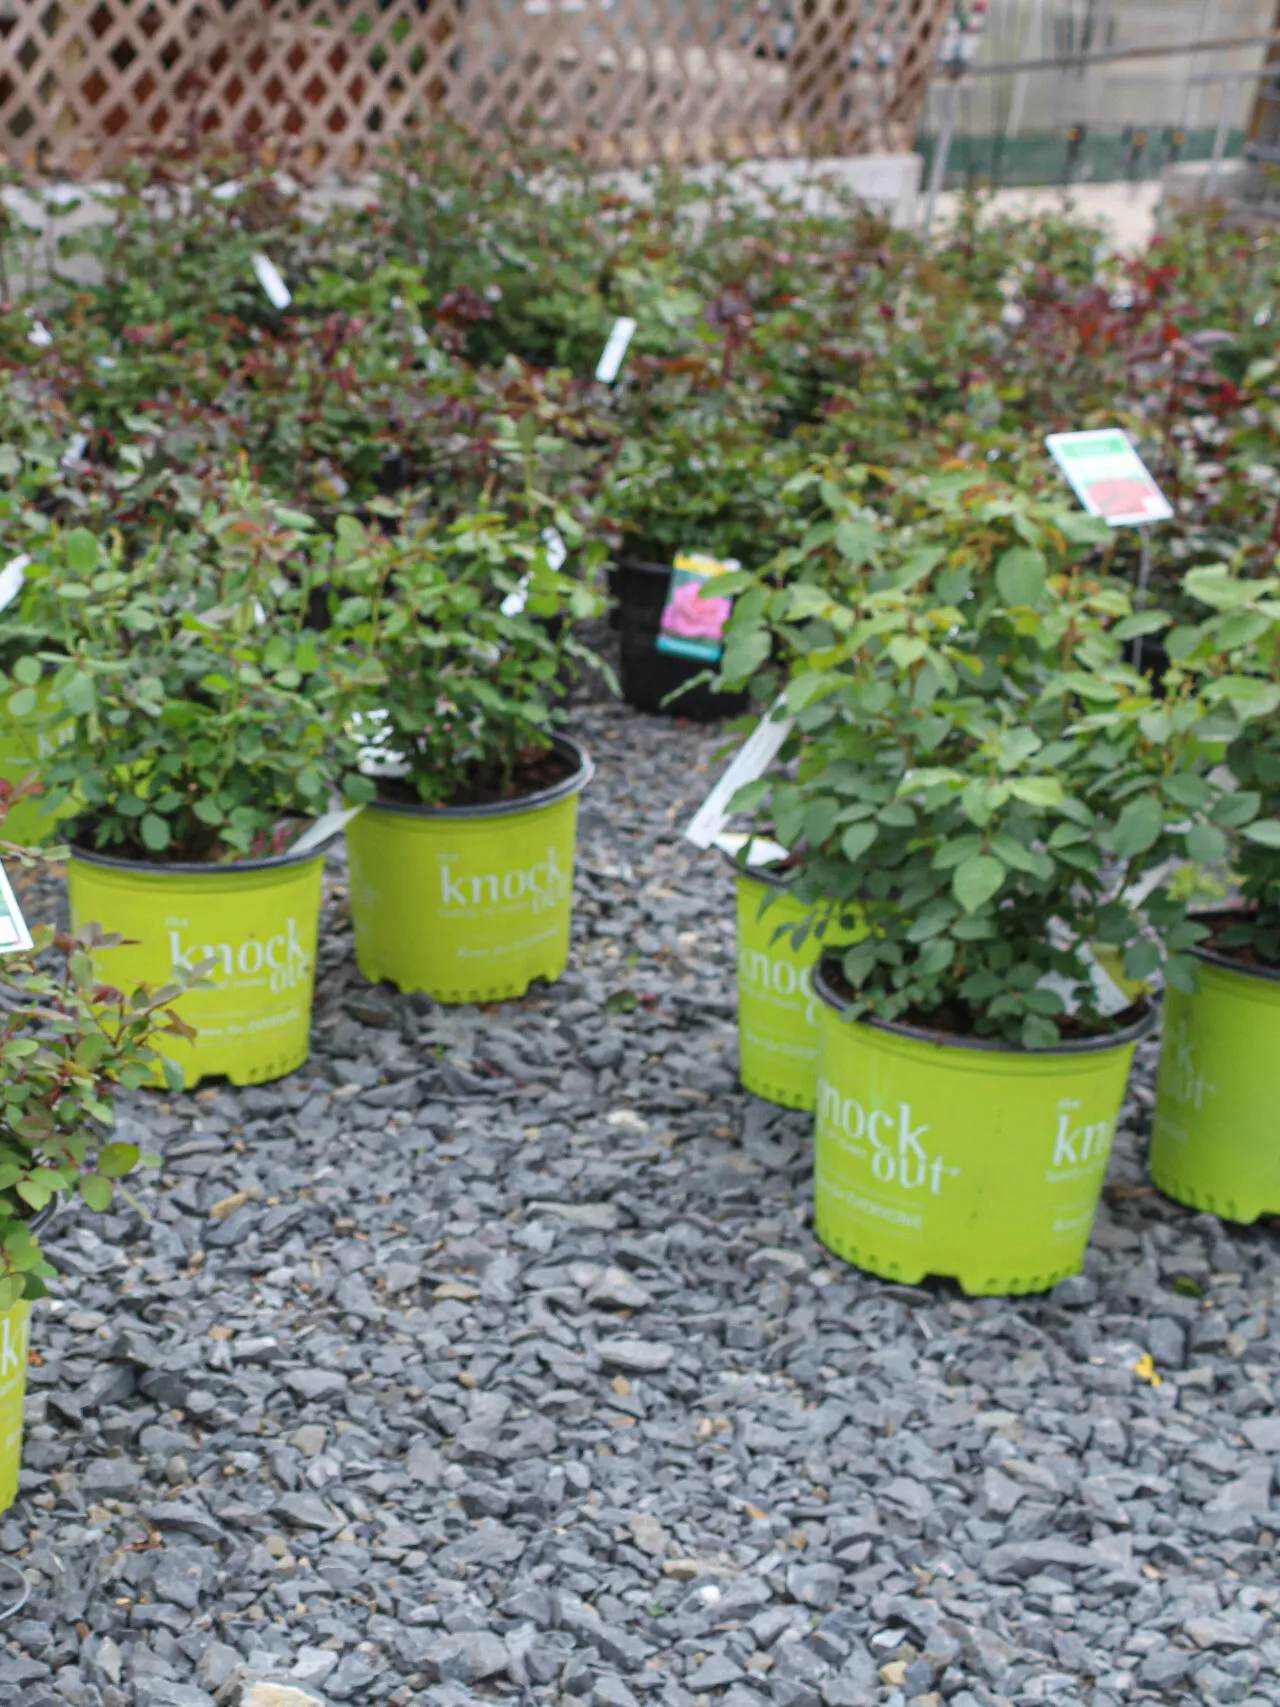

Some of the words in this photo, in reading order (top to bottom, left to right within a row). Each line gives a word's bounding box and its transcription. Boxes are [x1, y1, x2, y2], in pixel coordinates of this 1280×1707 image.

[439, 846, 562, 905] knock
[168, 918, 303, 976] knock
[819, 1084, 931, 1160] nock
[872, 1152, 947, 1195] out
